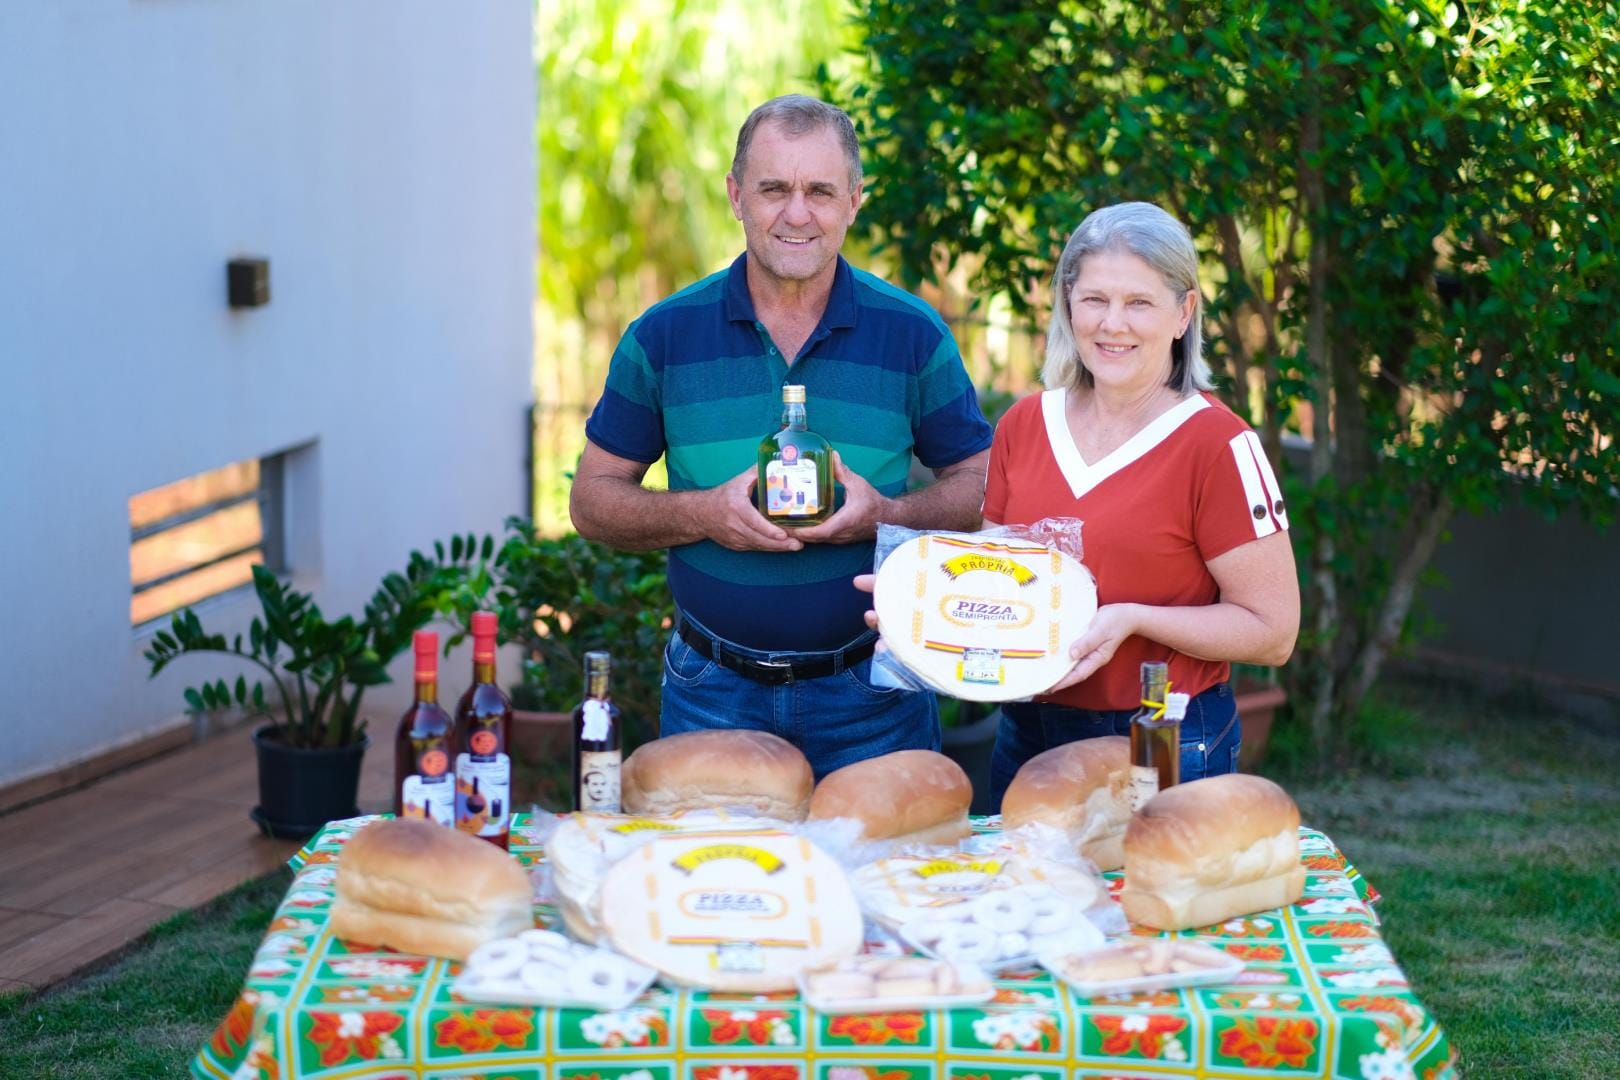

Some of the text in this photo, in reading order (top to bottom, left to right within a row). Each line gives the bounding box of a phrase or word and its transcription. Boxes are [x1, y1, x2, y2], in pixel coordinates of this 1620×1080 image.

[956, 601, 1013, 615] PIZZA
[952, 610, 1018, 621] SEMIPRONTA
[698, 893, 764, 904] PIZZA
